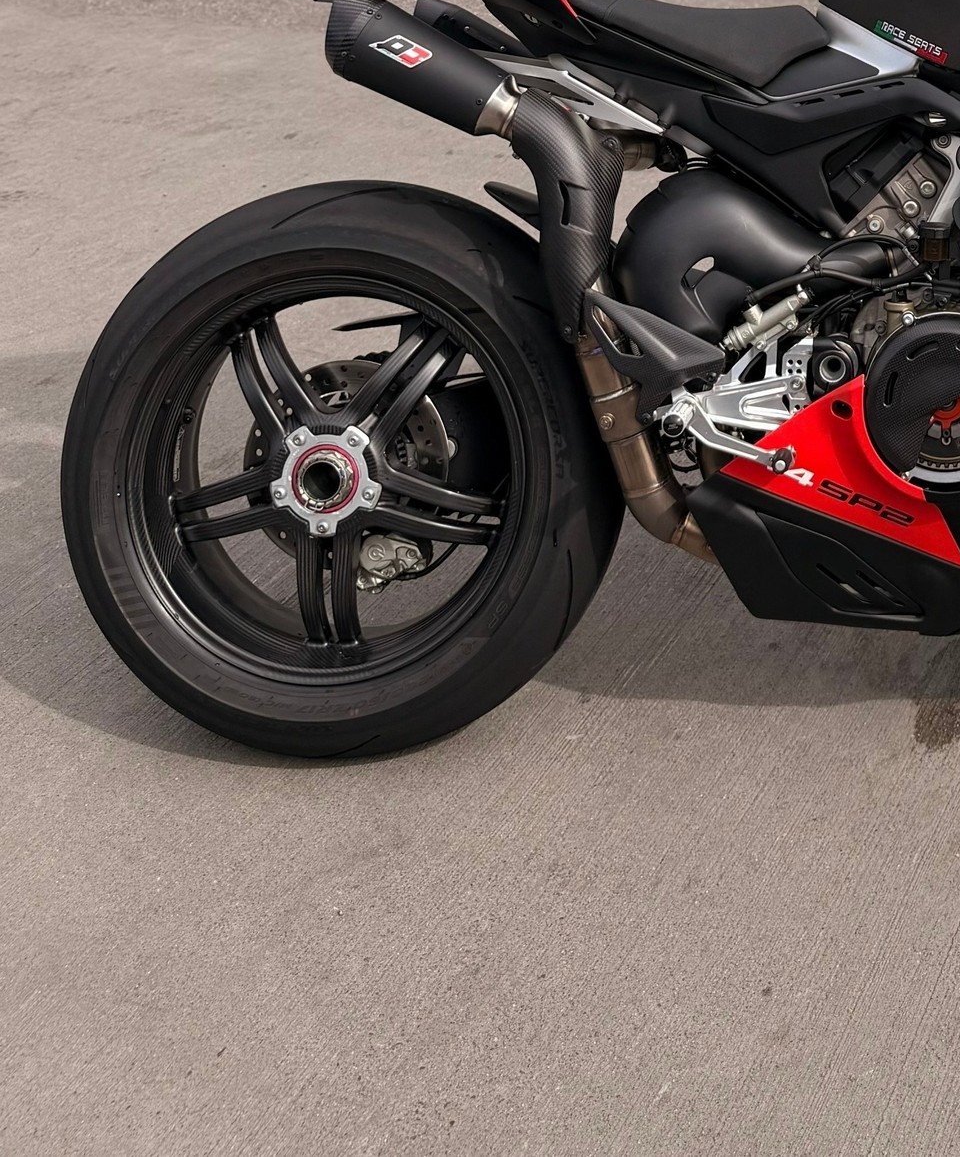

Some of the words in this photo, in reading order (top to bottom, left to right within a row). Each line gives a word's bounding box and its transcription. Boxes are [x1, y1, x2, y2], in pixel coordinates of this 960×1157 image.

[880, 21, 907, 40] RACE
[906, 34, 943, 57] SEATS
[816, 479, 916, 528] SP2
